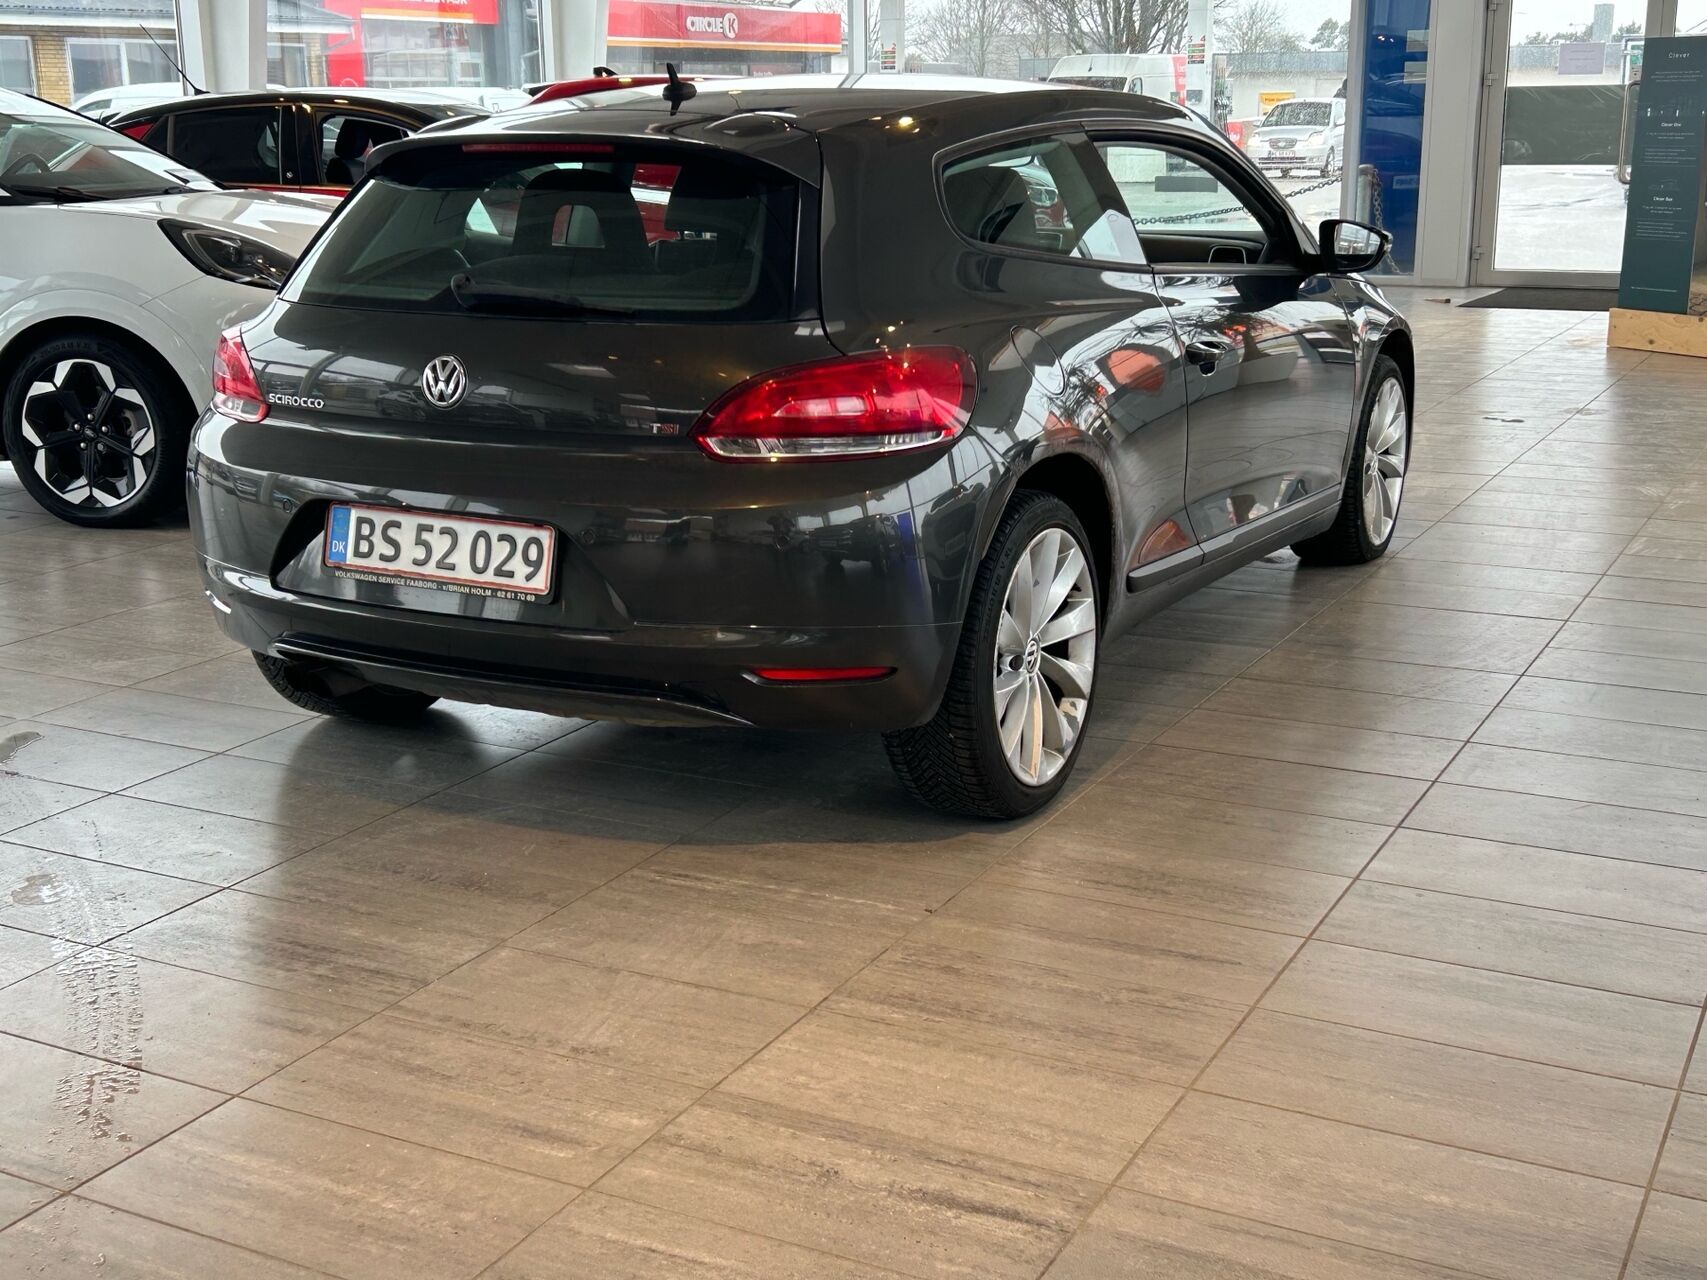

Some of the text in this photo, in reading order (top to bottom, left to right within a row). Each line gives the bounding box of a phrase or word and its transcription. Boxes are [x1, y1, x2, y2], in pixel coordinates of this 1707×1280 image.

[686, 15, 723, 33] CIRCLE
[268, 393, 325, 409] SCIROCCO
[331, 540, 346, 553] DK
[353, 516, 544, 583] BS 52 029
[335, 570, 378, 583] VOLKSWAGEN
[378, 576, 405, 586] SERVICE
[406, 579, 438, 589] FAABORG
[470, 587, 492, 596] HOLM
